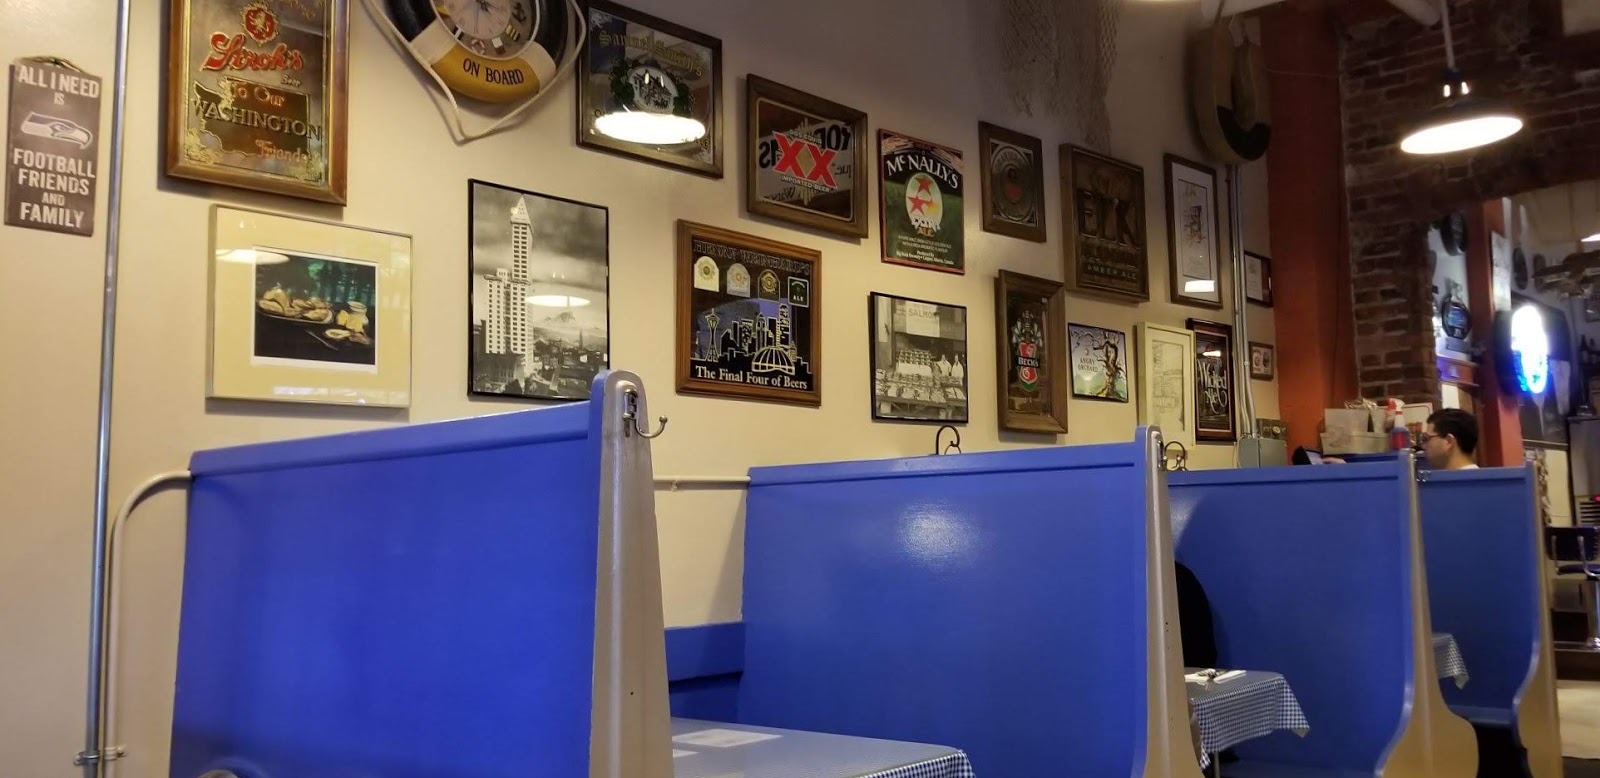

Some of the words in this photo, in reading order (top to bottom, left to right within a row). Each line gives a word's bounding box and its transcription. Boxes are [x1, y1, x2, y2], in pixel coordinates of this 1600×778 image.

[199, 31, 304, 71] Stroh's
[18, 64, 48, 88] ALL
[51, 72, 56, 89] I
[59, 75, 100, 98] NEED
[463, 58, 480, 78] ON
[485, 67, 525, 85] BOARD
[54, 92, 65, 105] IS
[191, 99, 322, 141] WASHINGTON
[13, 148, 96, 178] FOOTBALL
[772, 131, 838, 189] XX
[18, 168, 90, 195] FRIENDS
[41, 192, 66, 206] AND
[20, 202, 85, 228] FAMILY
[1121, 269, 1137, 280] ALE
[695, 365, 716, 379] The
[719, 368, 743, 382] Final
[746, 371, 770, 386] Four
[771, 375, 782, 387] of
[784, 375, 808, 390] Beers
[1197, 360, 1228, 392] Wicked
